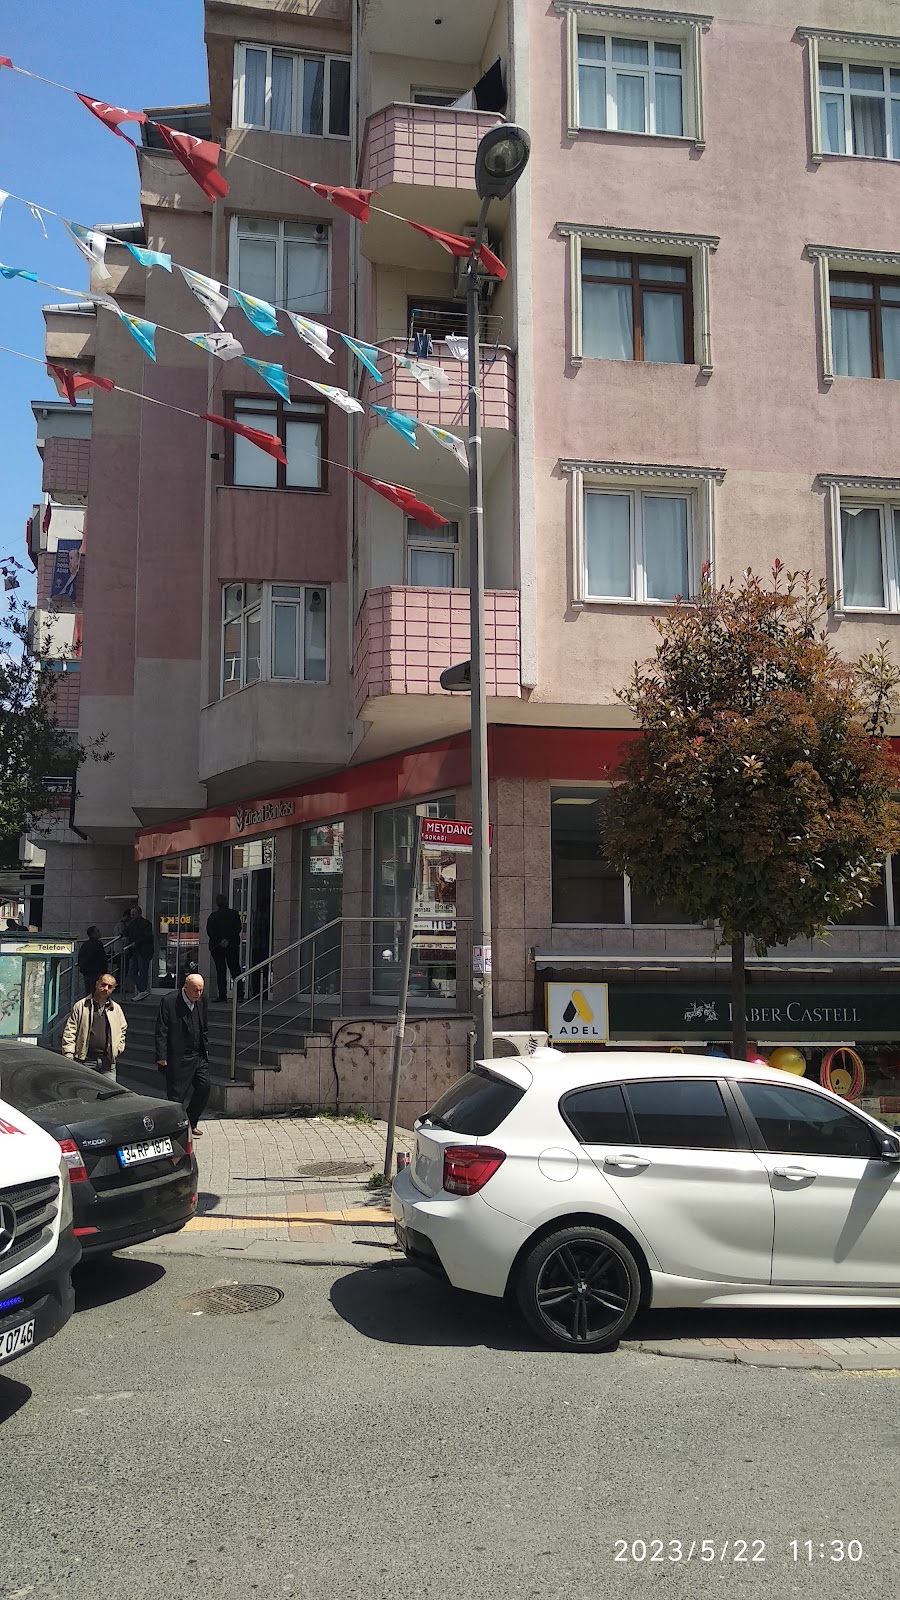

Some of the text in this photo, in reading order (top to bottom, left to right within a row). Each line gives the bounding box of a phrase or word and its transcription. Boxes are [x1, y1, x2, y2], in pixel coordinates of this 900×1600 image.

[244, 801, 293, 826] Ziraat Bankası
[426, 822, 473, 836] MEYDANC
[559, 1026, 599, 1035] ADEL
[123, 1136, 172, 1161] 34 RP 1875
[5, 1322, 34, 1354] 0746
